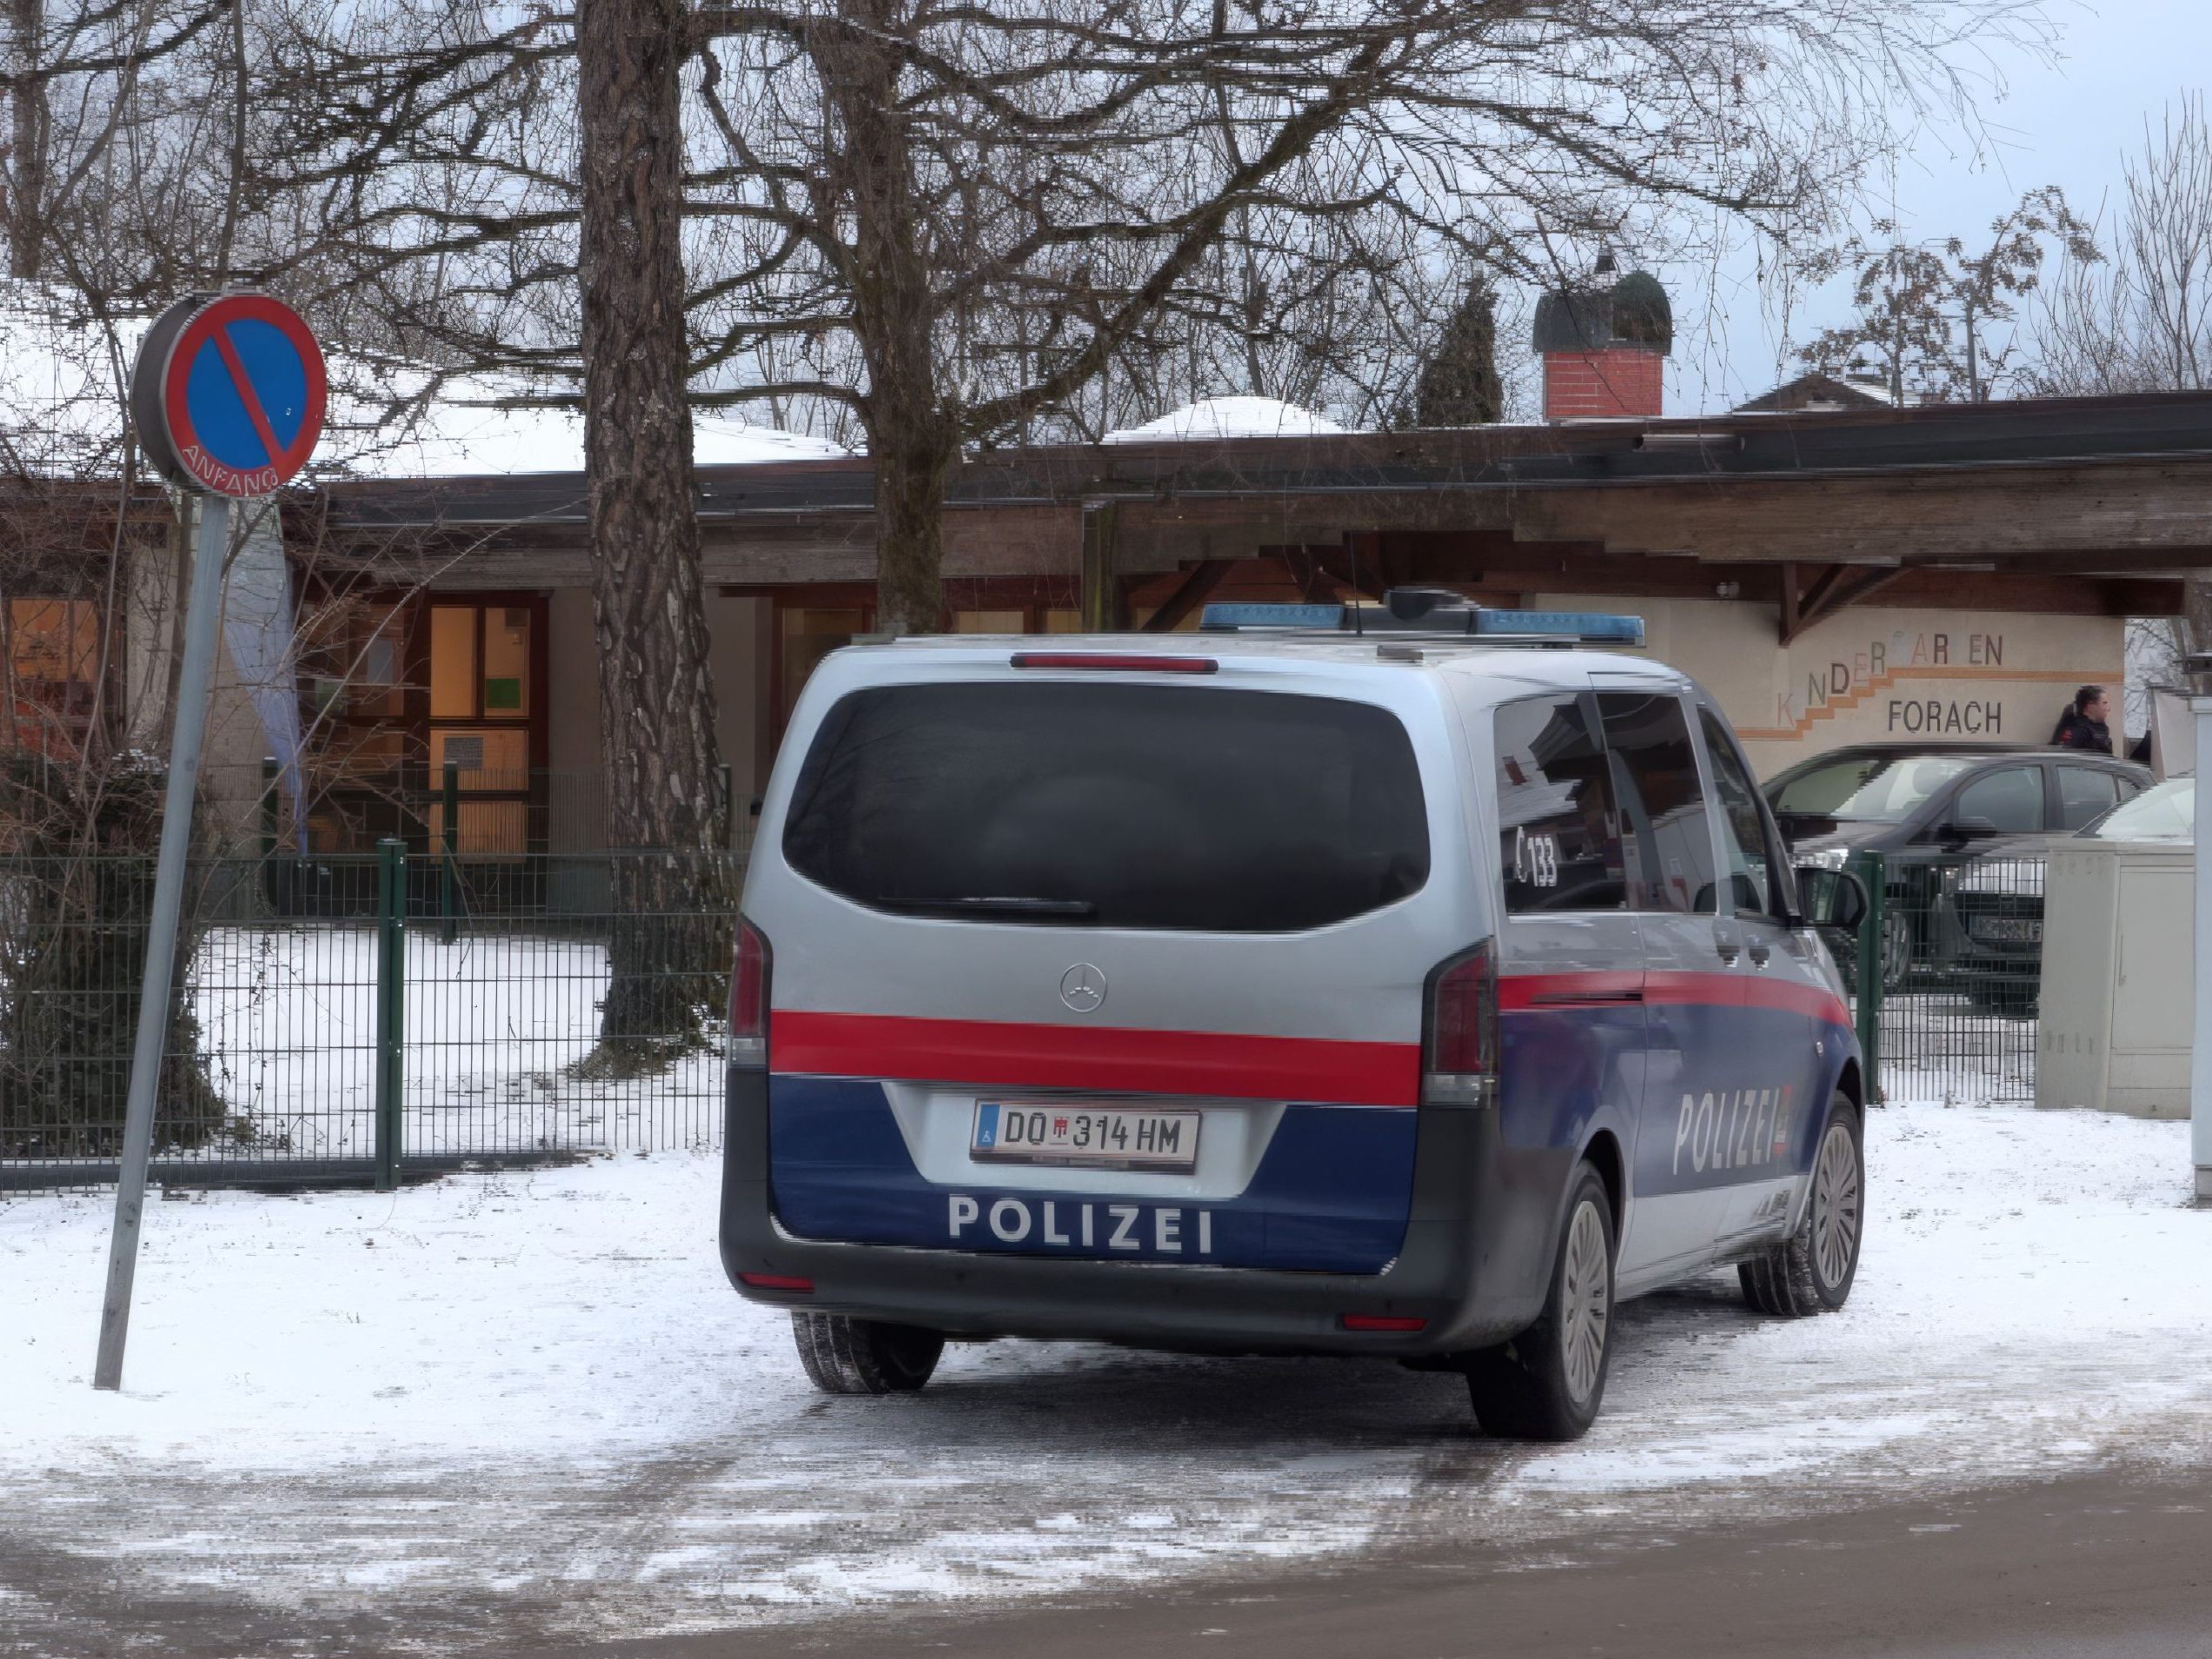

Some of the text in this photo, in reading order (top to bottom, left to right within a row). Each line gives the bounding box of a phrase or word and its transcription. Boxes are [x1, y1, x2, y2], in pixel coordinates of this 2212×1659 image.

[183, 445, 279, 496] ANFANG
[1777, 631, 2003, 727] KNDERAREN
[1888, 700, 2002, 733] FORACH
[1073, 1116, 1128, 1150] 314
[1136, 1118, 1181, 1154] HM
[1673, 1087, 1780, 1176] POLIZEI
[948, 1194, 1212, 1254] POLIZEI
